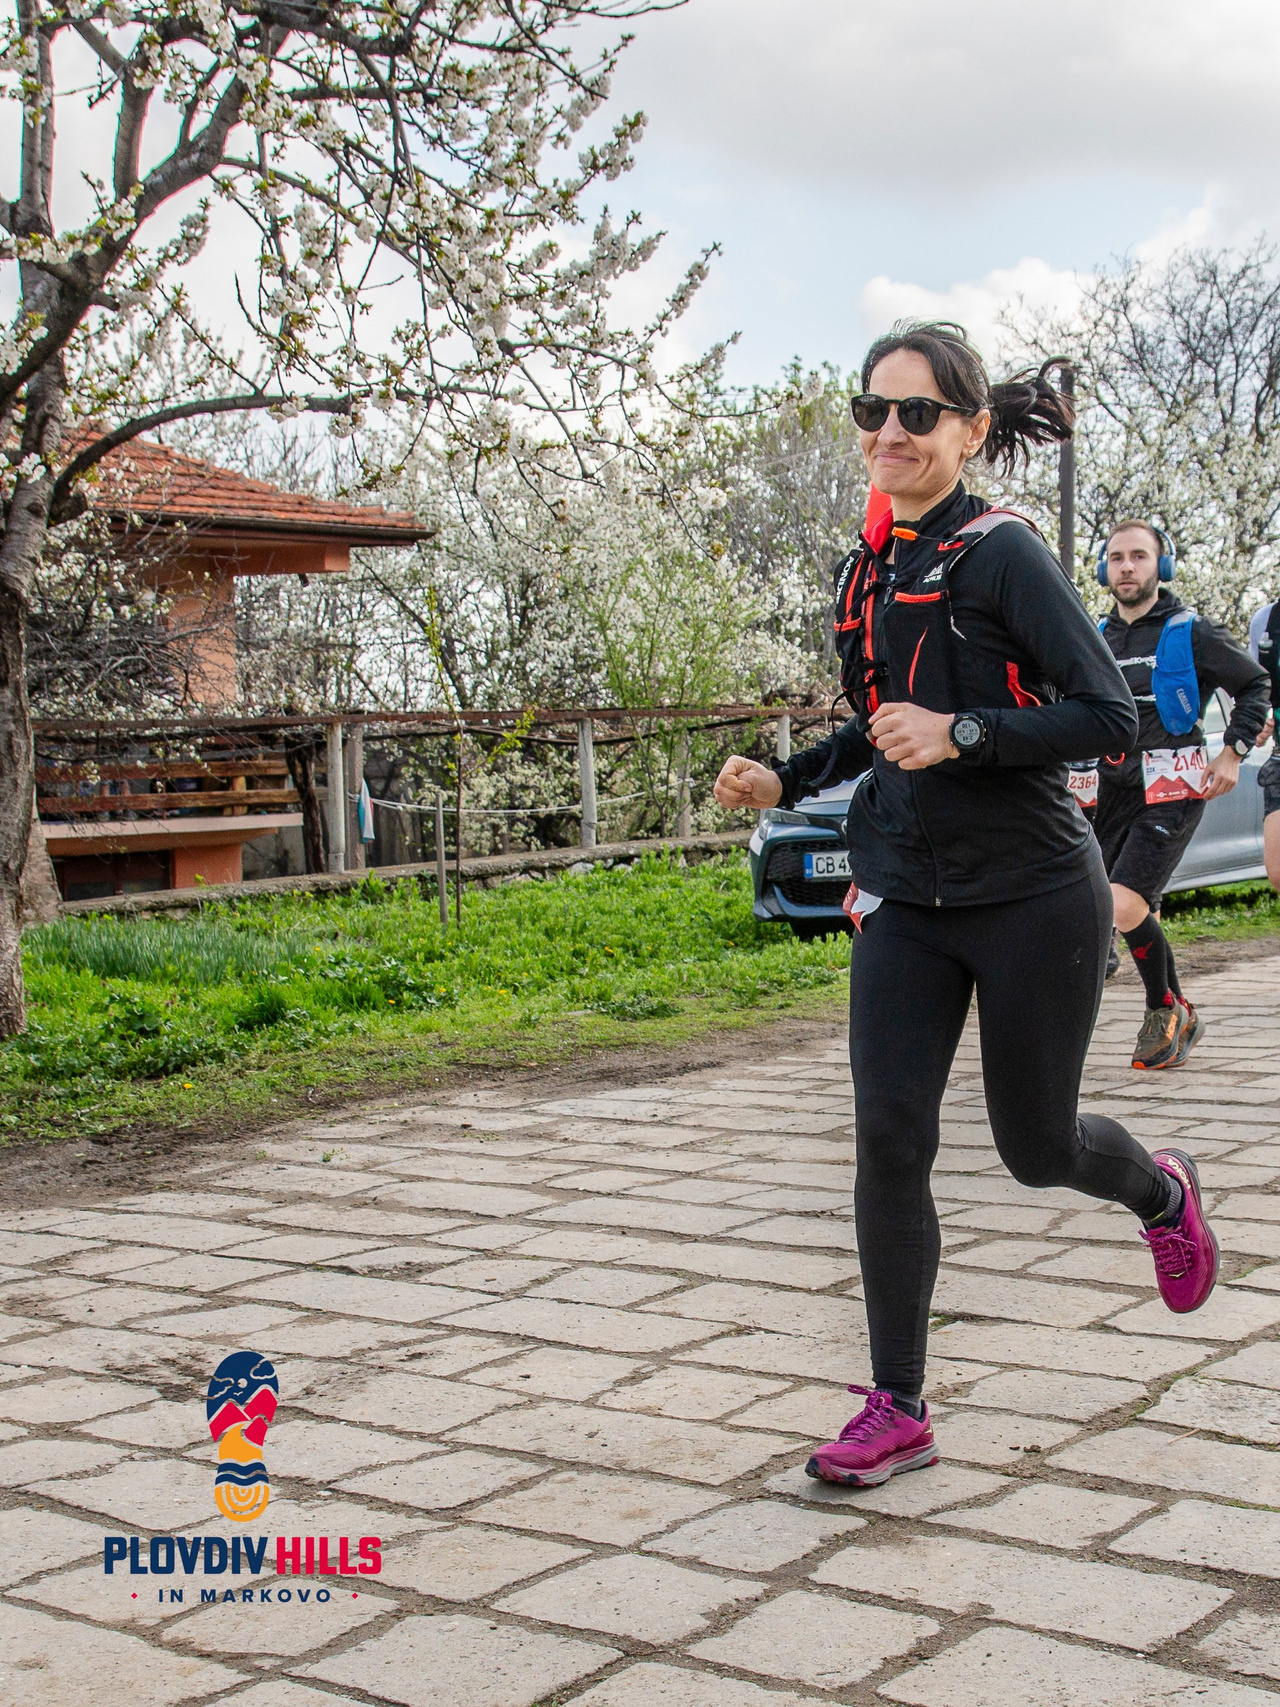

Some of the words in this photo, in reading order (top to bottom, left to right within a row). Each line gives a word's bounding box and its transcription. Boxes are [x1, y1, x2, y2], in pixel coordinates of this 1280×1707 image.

[1172, 751, 1206, 772] 2140
[1068, 774, 1097, 790] 2364
[838, 857, 852, 874] 4
[1168, 1157, 1191, 1189] HOKA
